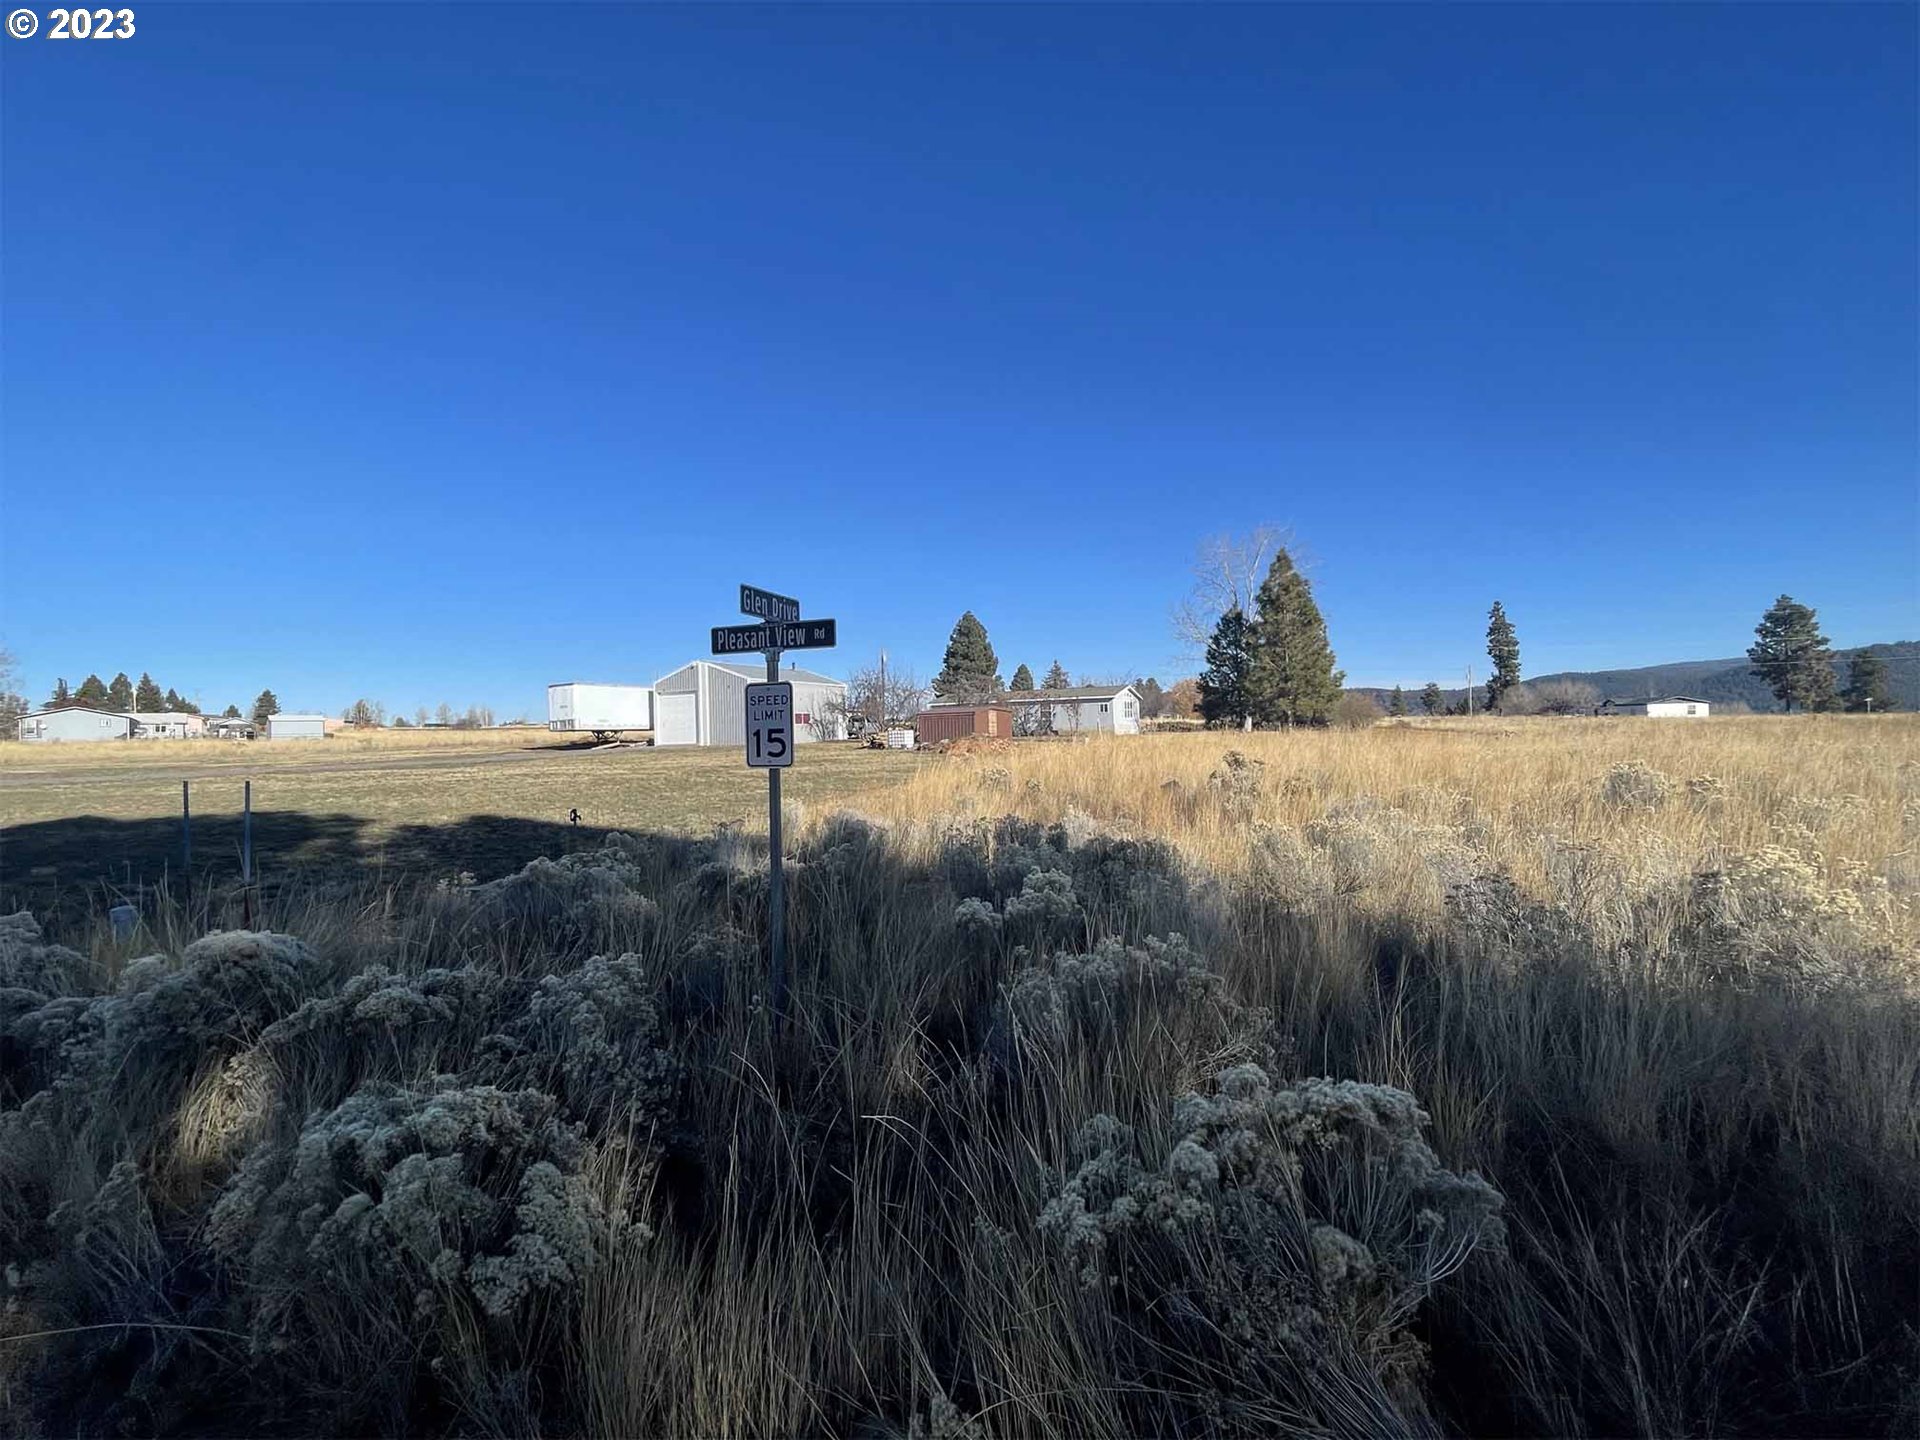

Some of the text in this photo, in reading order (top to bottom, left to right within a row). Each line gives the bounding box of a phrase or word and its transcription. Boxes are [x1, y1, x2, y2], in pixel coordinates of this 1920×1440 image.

[743, 589, 798, 622] Glen Drive
[718, 626, 825, 651] Pleasant View Rd
[750, 694, 789, 706] SPEED
[753, 709, 785, 721] LIMIT
[752, 728, 787, 758] 15
